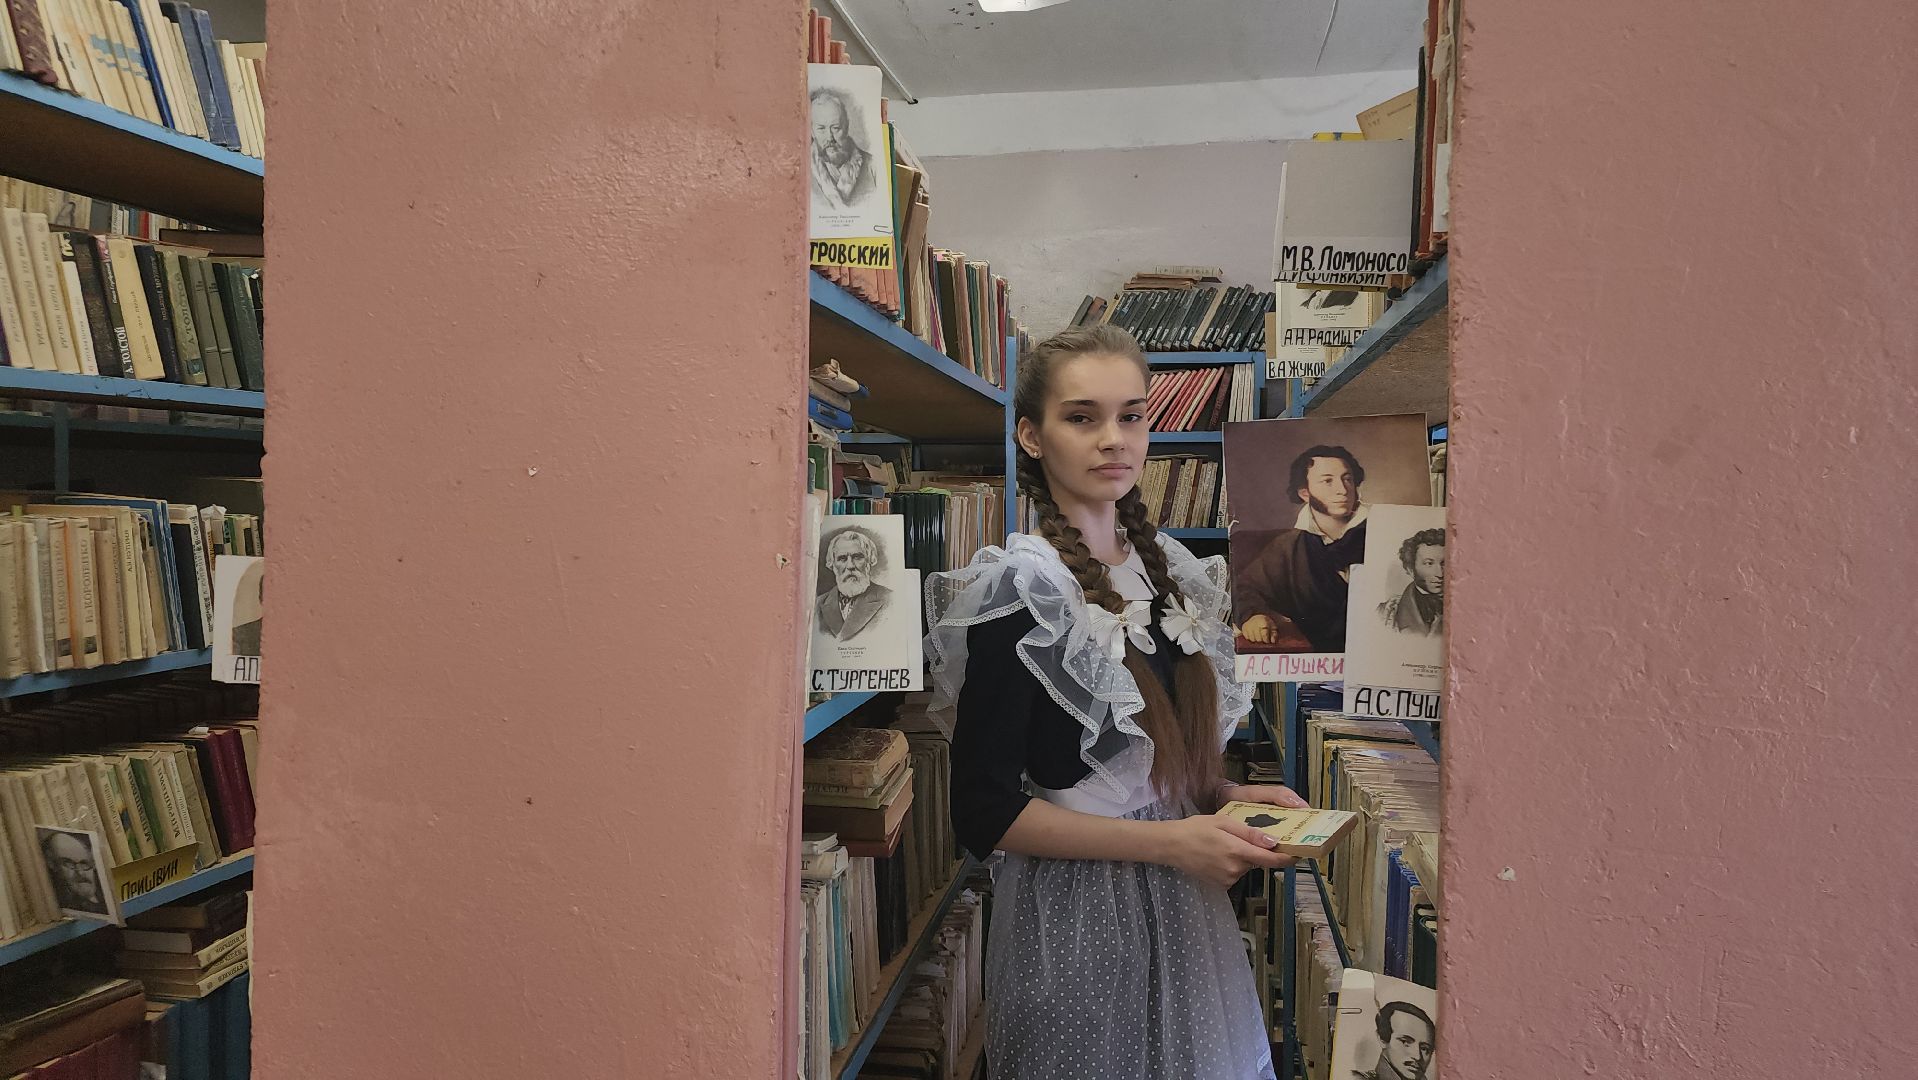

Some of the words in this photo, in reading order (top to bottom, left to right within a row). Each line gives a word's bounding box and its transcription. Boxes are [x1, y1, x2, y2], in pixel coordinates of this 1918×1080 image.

[115, 326, 131, 364] ТОЛСТОЙ
[1308, 328, 1367, 348] РАДИЩЕ
[826, 668, 910, 690] ТУРГЕНЕВ
